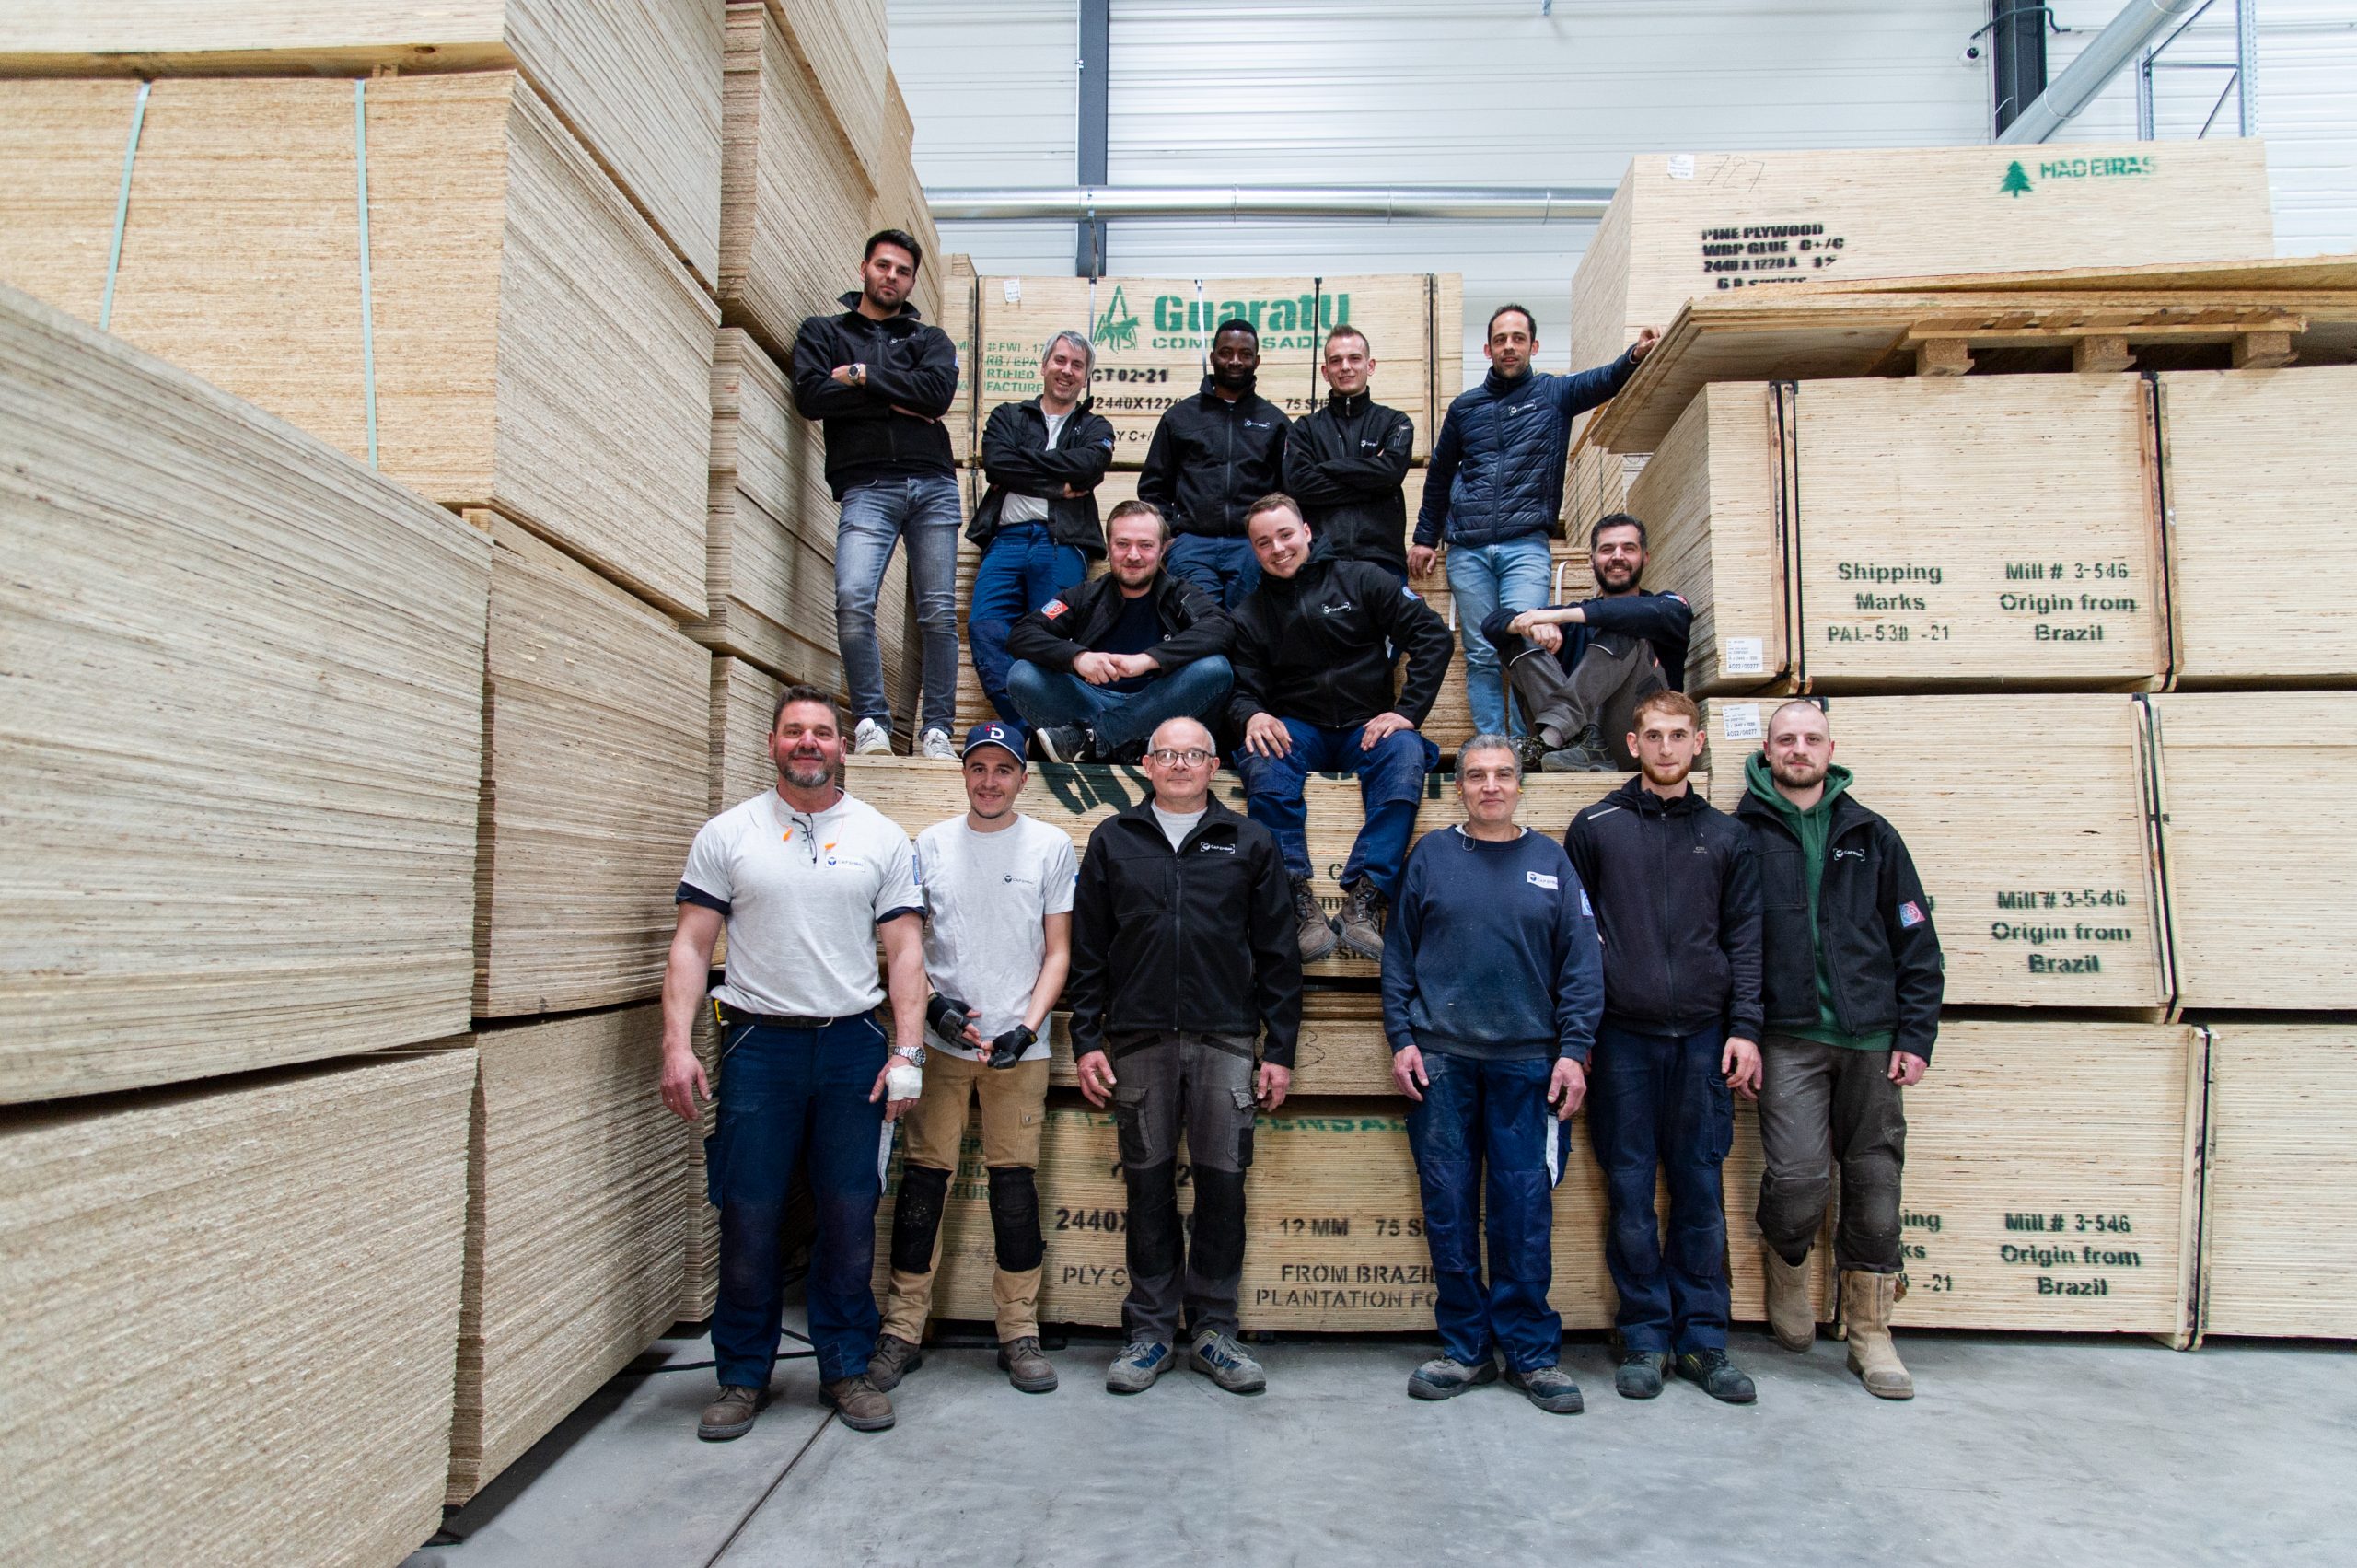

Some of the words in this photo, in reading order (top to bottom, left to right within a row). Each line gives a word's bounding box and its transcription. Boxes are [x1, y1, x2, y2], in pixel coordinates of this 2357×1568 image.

[2040, 157, 2155, 179] MADEIRAS
[1701, 227, 1740, 240] PINE
[1743, 224, 1824, 238] PLYWOOD
[1747, 240, 1789, 254] GLUE
[986, 369, 1035, 379] RTIFIED
[1838, 563, 1942, 584] Shipping
[2006, 563, 2043, 579] Mill
[2049, 563, 2063, 580] #
[2073, 563, 2129, 579] 3-546
[1855, 592, 1926, 610] Marks
[2000, 593, 2073, 614] Origin
[2081, 593, 2137, 613] from
[2034, 623, 2104, 641] Brazil
[1997, 890, 2036, 909] Mill
[2042, 890, 2056, 909] #
[2062, 889, 2127, 908] 3-546
[1991, 922, 2066, 945] Origin
[2075, 923, 2131, 941] from
[2028, 954, 2100, 973] Brazil
[1311, 1217, 1349, 1236] MM
[1376, 1219, 1400, 1236] 75
[2005, 1213, 2044, 1231] Mill
[2050, 1214, 2064, 1232] #
[2075, 1214, 2131, 1233] 3-546
[2001, 1244, 2075, 1268] Origin
[2083, 1246, 2141, 1267] from
[1063, 1267, 1105, 1285] PLY
[1282, 1264, 1348, 1283] FROM
[2038, 1276, 2107, 1295] Brazil
[1256, 1289, 1403, 1307] PLANTATION
